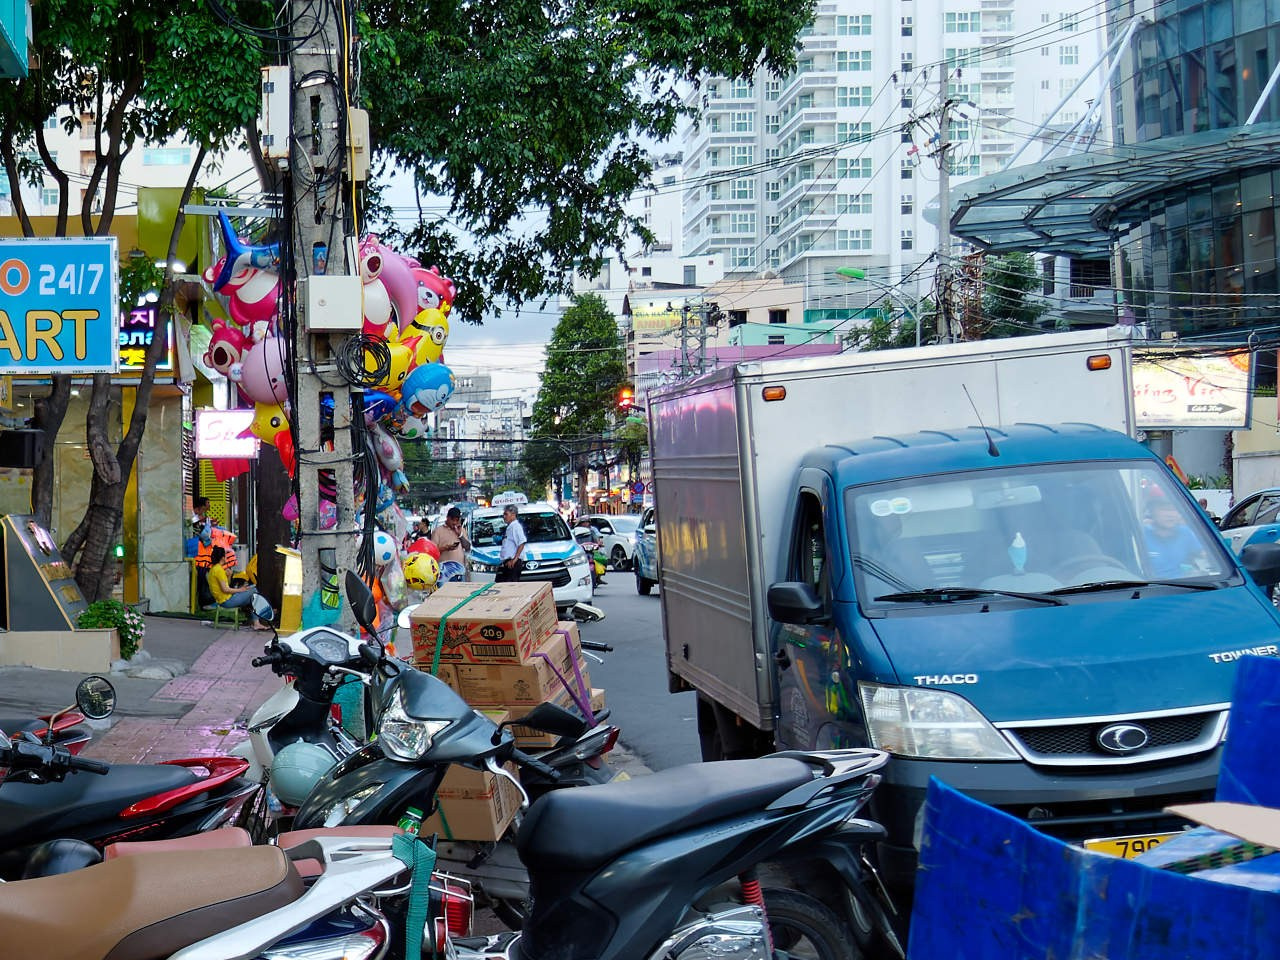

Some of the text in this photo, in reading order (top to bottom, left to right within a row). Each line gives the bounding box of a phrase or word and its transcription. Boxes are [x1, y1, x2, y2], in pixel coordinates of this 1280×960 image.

[39, 263, 104, 295] 24/7
[482, 628, 494, 637] 20
[1208, 645, 1279, 664] TOWNER
[913, 673, 979, 686] THACO
